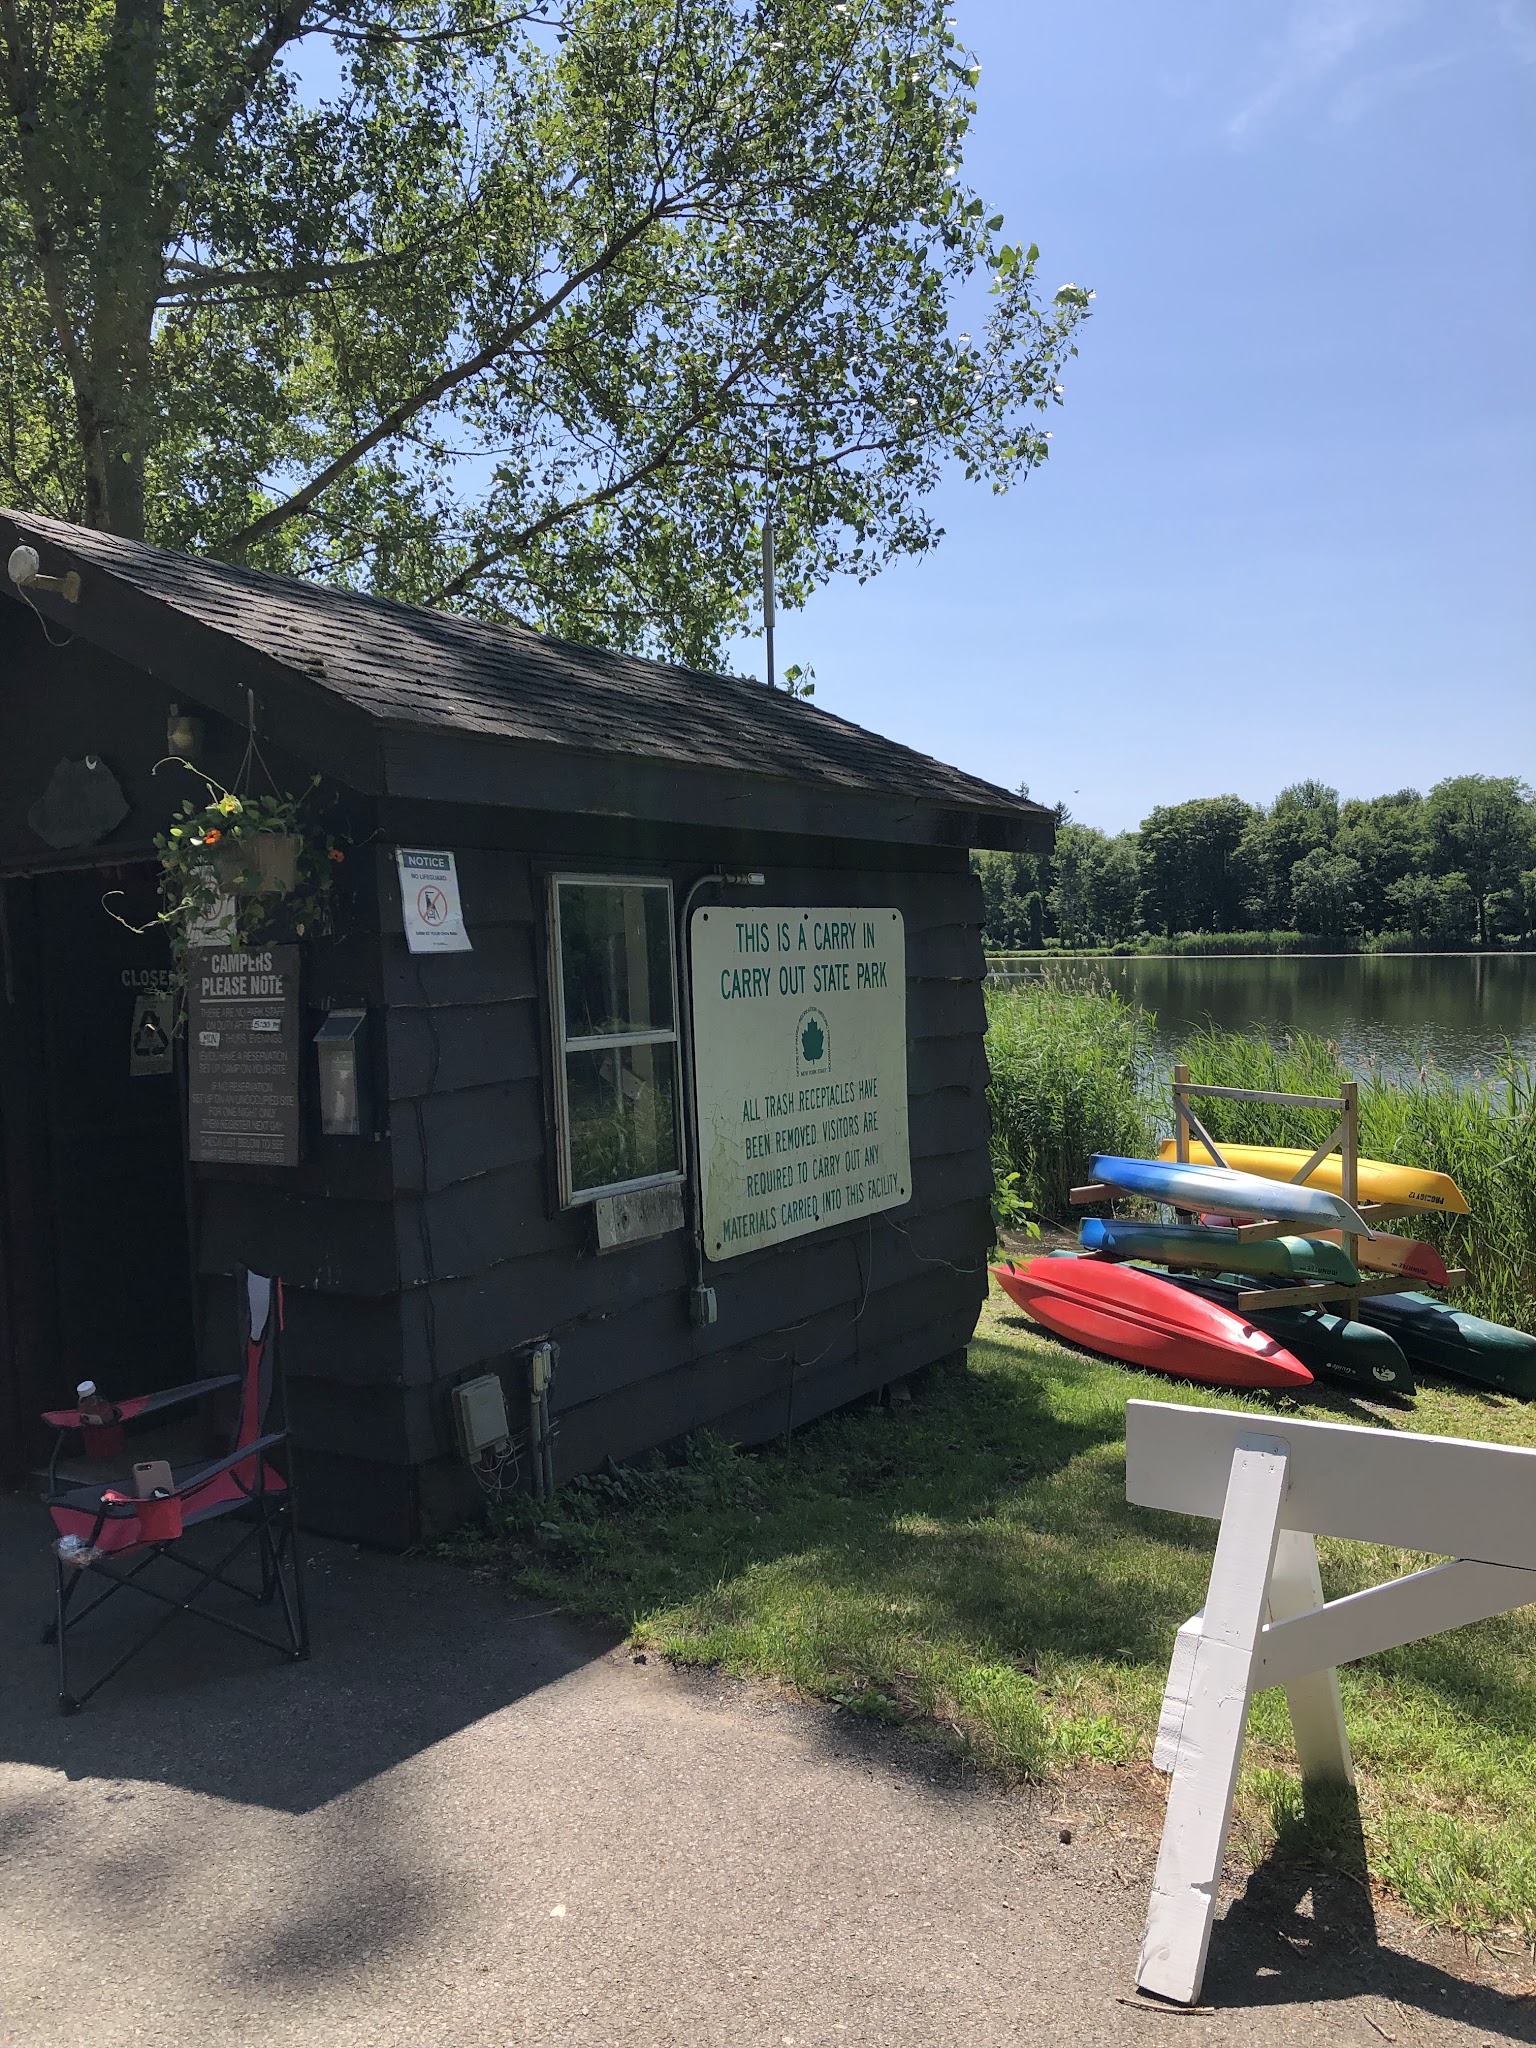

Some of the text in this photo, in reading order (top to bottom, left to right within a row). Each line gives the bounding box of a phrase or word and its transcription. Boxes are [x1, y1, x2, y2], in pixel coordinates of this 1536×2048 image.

[408, 856, 445, 867] NOTICE
[736, 922, 875, 953] THIS IS A CARRY IN
[211, 952, 273, 974] CAMPERS
[201, 974, 283, 996] PLEASE NOTE
[720, 961, 887, 999] CARRY OUT STATE PARK
[200, 1006, 286, 1018] THERE ARE NO PARK STAFF
[206, 1020, 217, 1030] ON
[249, 1033, 283, 1044] EVENINGS
[243, 1051, 288, 1061] RESERVATION
[199, 1063, 211, 1074] SET
[212, 1063, 221, 1073] UP
[222, 1063, 240, 1074] CAMP
[272, 1063, 287, 1075] SITE
[229, 1081, 273, 1093] RESERVATION
[192, 1093, 204, 1104] SET
[205, 1094, 214, 1104] UP
[236, 1094, 279, 1106] UNOCCUPIED
[280, 1095, 294, 1106] SITE
[742, 1078, 878, 1123] ALL TRASH RECEPTACLES HAVE
[209, 1106, 277, 1119] FOR ONE NIGHT ONLY
[220, 1119, 251, 1130] REGISTER
[252, 1120, 269, 1131] NEXT
[745, 1135, 771, 1160] BEEN
[822, 1115, 859, 1143] VISITORS
[863, 1111, 879, 1133] ARE
[237, 1138, 260, 1149] BELOW
[271, 1139, 285, 1150] SEE
[747, 1145, 880, 1198] REQUIRED TO CARRY OUT ANY
[1408, 1191, 1445, 1205] PRODIGY 12
[723, 1207, 777, 1243] MATERIALS
[781, 1194, 818, 1225] CARRIED
[822, 1185, 842, 1213] INTO
[846, 1184, 865, 1206] THIS
[1306, 1265, 1338, 1275] MANATEE
[1398, 1262, 1428, 1276] MANATEE
[1332, 1363, 1352, 1374] Guide
